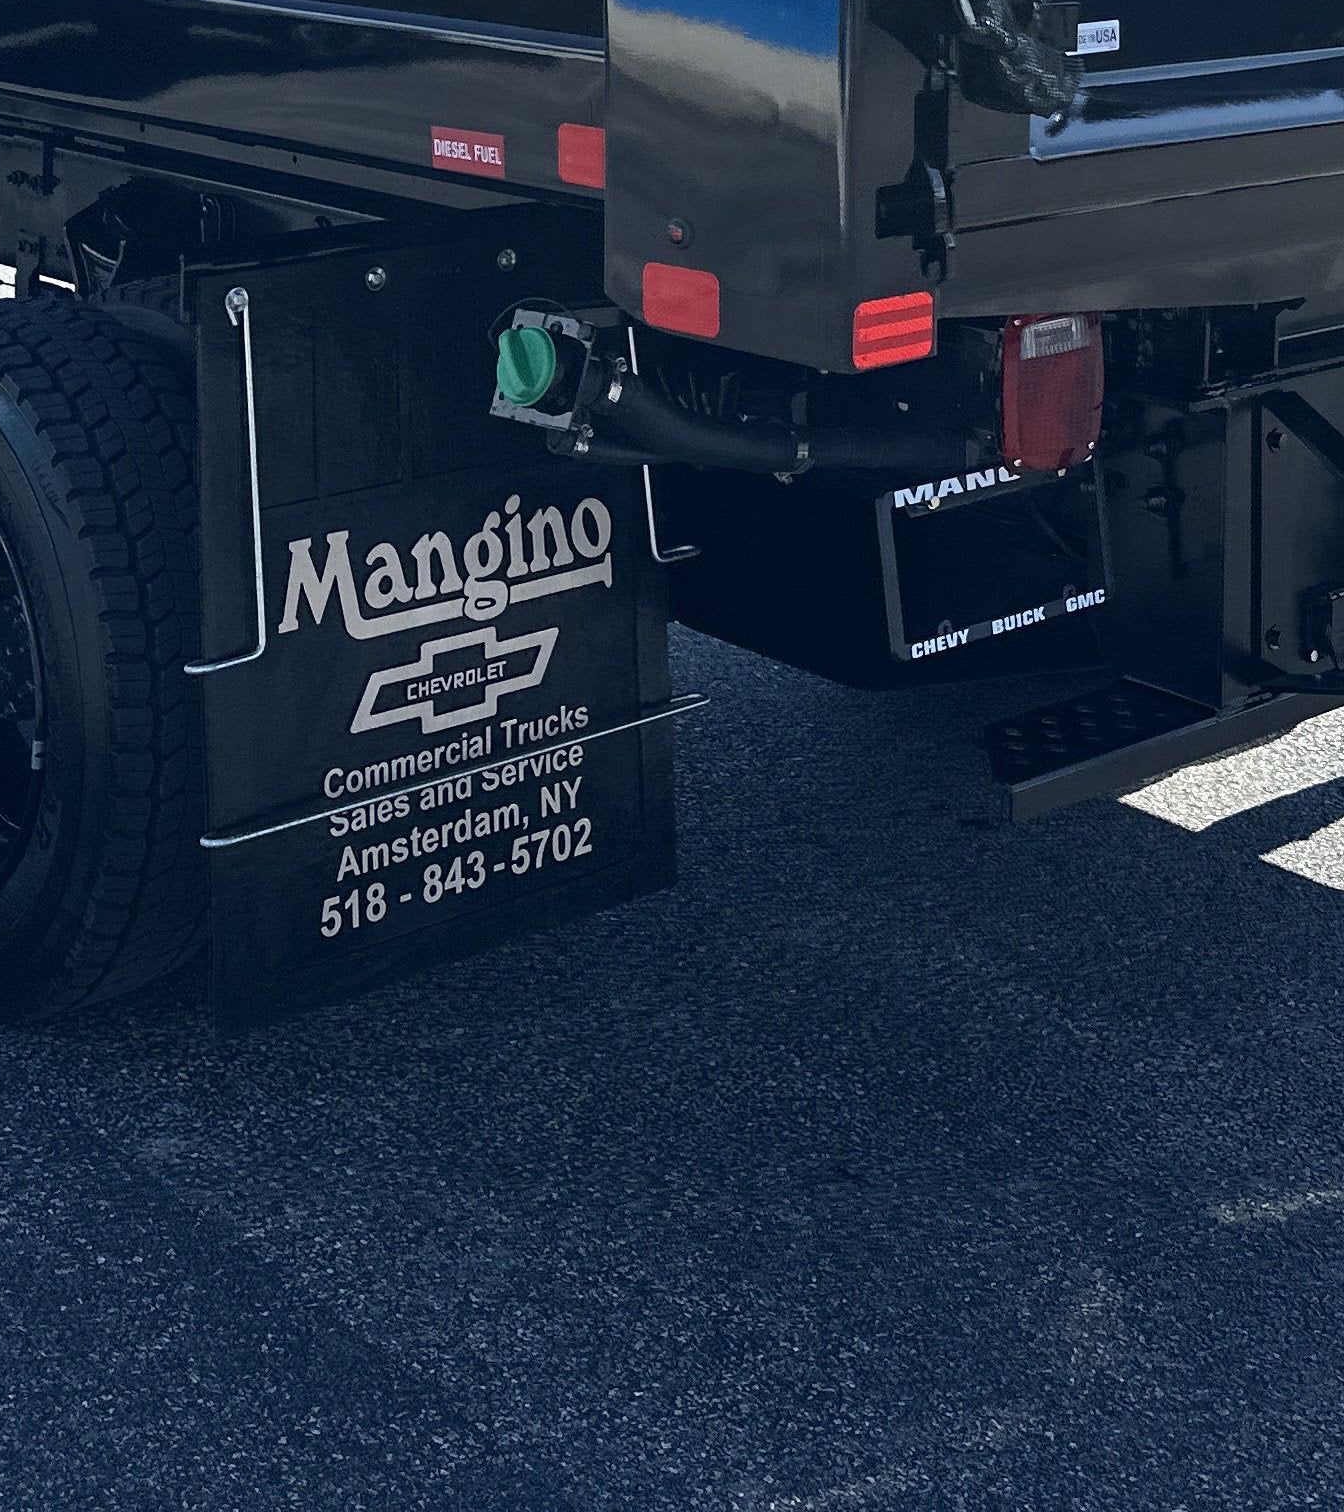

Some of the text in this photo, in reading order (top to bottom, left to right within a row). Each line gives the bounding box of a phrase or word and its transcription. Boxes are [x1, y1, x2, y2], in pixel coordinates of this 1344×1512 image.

[1096, 28, 1117, 44] USA
[433, 138, 502, 165] DIESEL FUEL
[278, 494, 613, 640] Mangino
[911, 589, 1105, 659] CHEVY BUICK GMC
[407, 660, 507, 701] CHEVROLET
[324, 704, 589, 799] Commercial Trucks
[330, 744, 584, 838] Sales and Service
[336, 776, 583, 882] Amsterdam, NY
